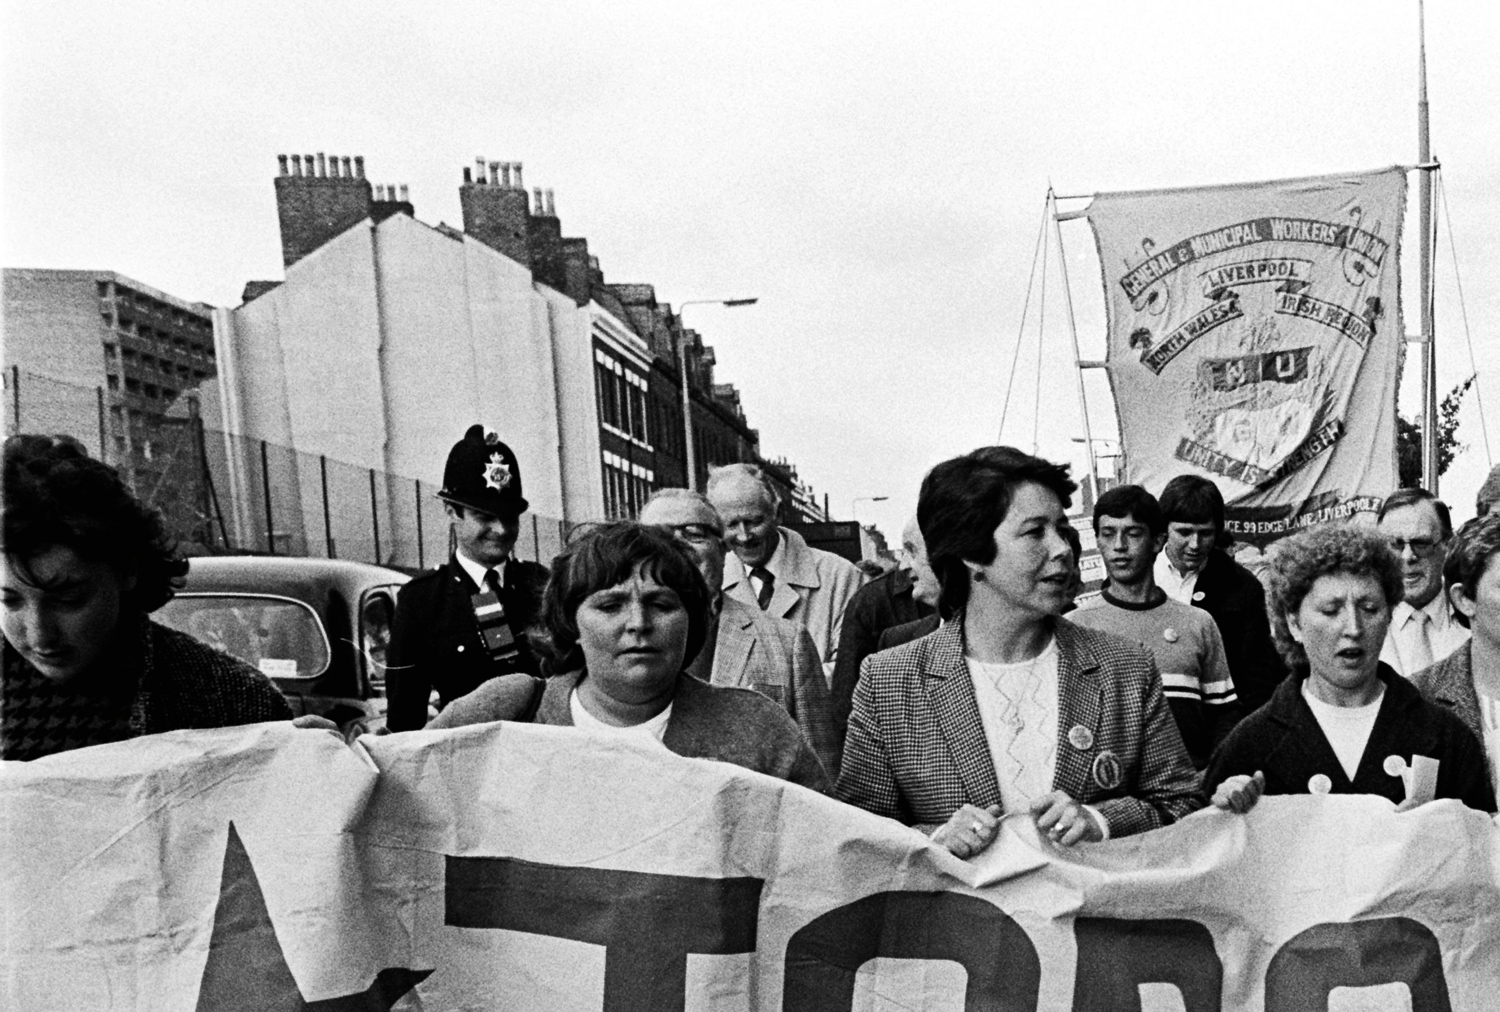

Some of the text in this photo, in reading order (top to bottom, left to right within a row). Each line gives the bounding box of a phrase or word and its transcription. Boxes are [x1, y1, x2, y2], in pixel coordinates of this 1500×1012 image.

[1121, 252, 1177, 297] GENERAL
[1191, 222, 1262, 259] MUNICIPAL
[1270, 218, 1338, 244] WORKERS
[1345, 227, 1385, 263] UNION
[1207, 261, 1299, 288] LIVERPOOL
[1145, 303, 1230, 370] NORTH WALES
[1281, 294, 1371, 344] IRISH REGION
[1275, 353, 1295, 378] U
[1183, 440, 1237, 476] UNITY
[1240, 465, 1260, 484] IS
[1243, 521, 1257, 534] 99
[1257, 520, 1284, 534] EDGE
[1318, 497, 1371, 522] LIVERPOOL
